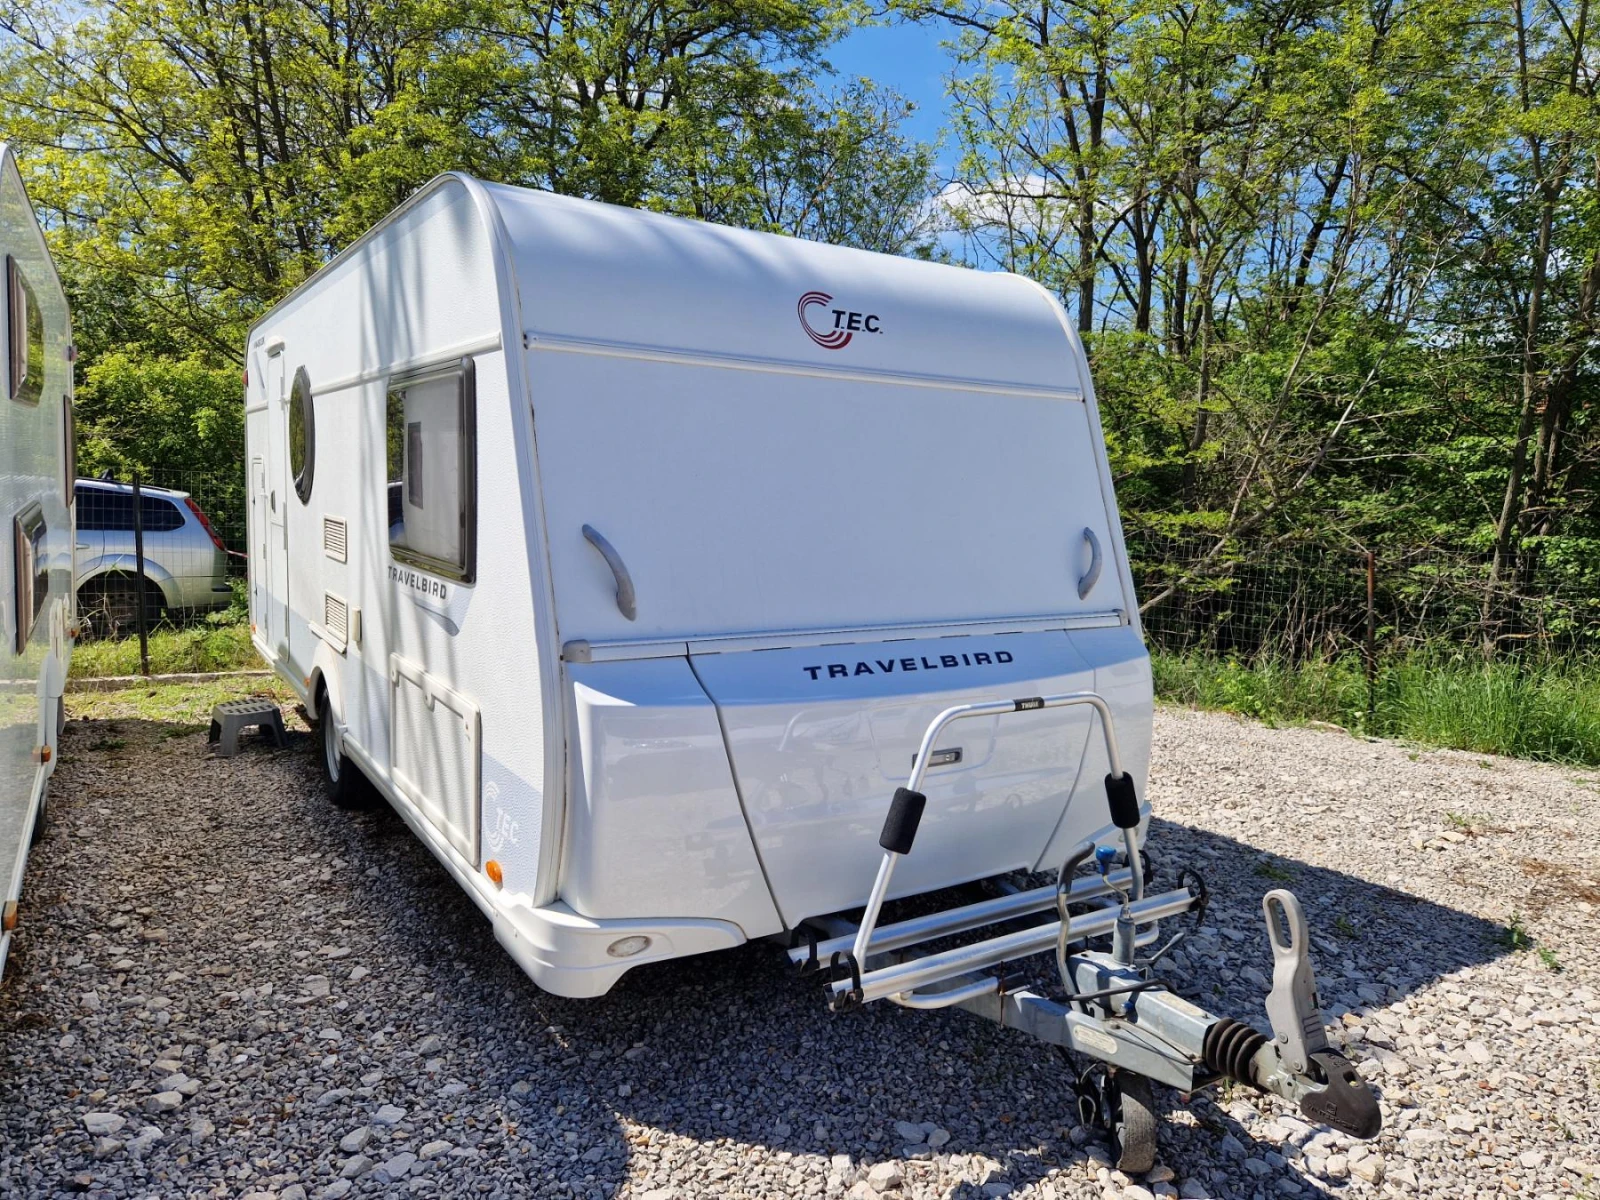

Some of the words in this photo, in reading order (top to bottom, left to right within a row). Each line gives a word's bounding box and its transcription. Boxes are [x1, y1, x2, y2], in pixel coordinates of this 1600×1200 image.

[832, 309, 883, 334] T.E.C.
[387, 566, 447, 600] TRAVELBIRD
[803, 651, 1014, 680] TRAVELBIRD
